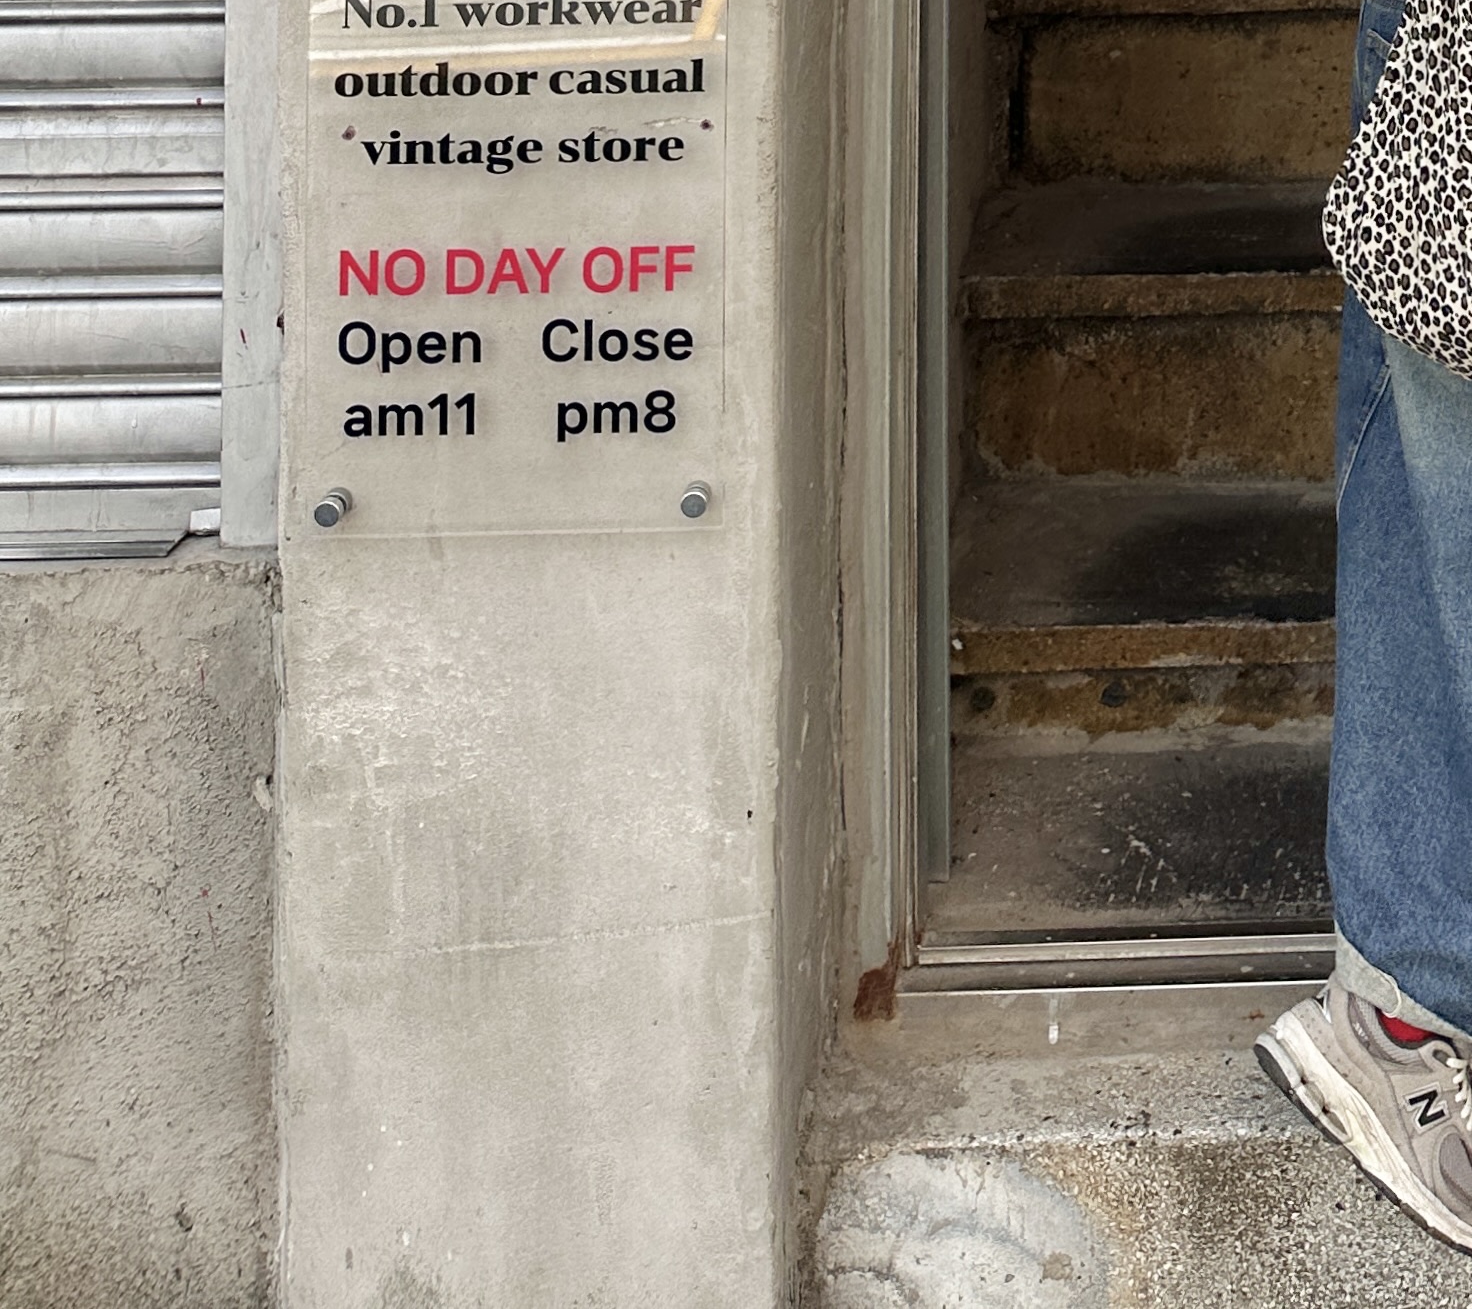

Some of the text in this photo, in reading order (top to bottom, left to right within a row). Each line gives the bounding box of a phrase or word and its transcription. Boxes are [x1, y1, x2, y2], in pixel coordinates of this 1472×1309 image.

[335, 58, 706, 97] outdoor casual
[362, 129, 686, 174] vintage store
[340, 244, 697, 296] NO DAY OFF
[339, 318, 695, 373] Open Close
[344, 389, 677, 442] am11 pm8
